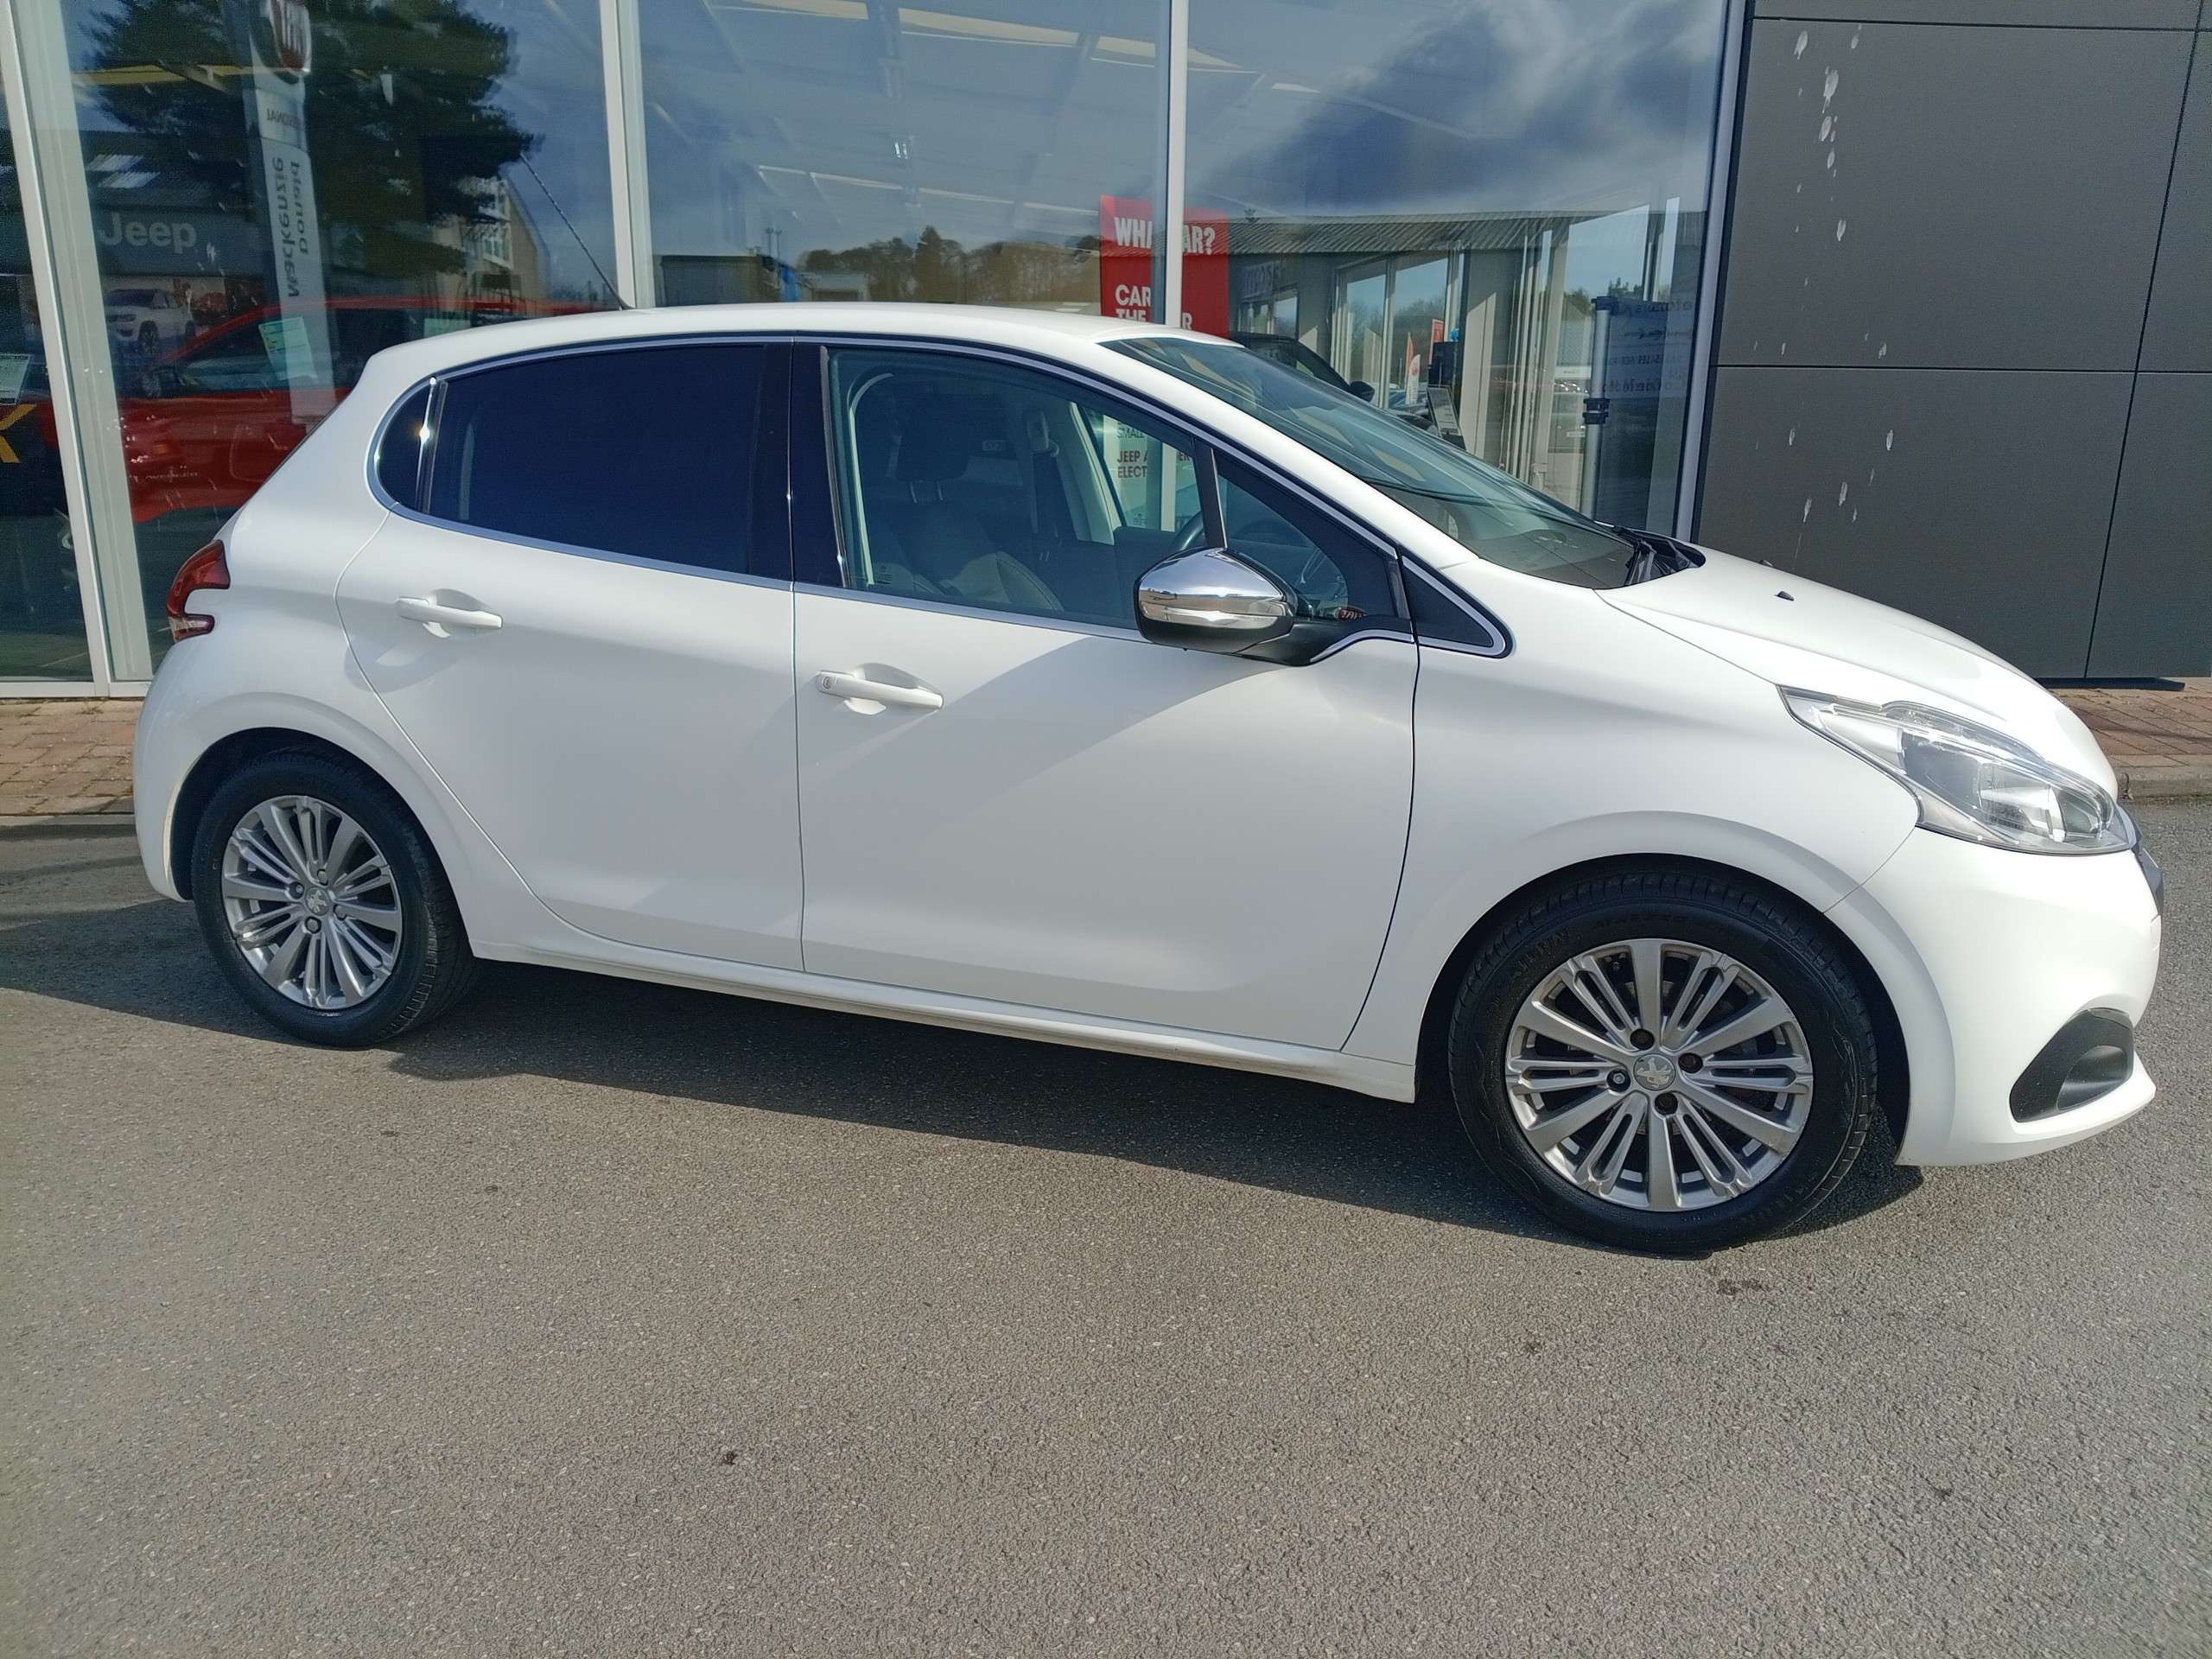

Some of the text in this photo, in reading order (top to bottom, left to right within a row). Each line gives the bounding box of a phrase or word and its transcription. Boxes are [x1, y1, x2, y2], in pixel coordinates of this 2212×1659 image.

[103, 212, 197, 254] Jeep
[1116, 284, 1151, 307] CAR
[1117, 450, 1141, 463] JEEP
